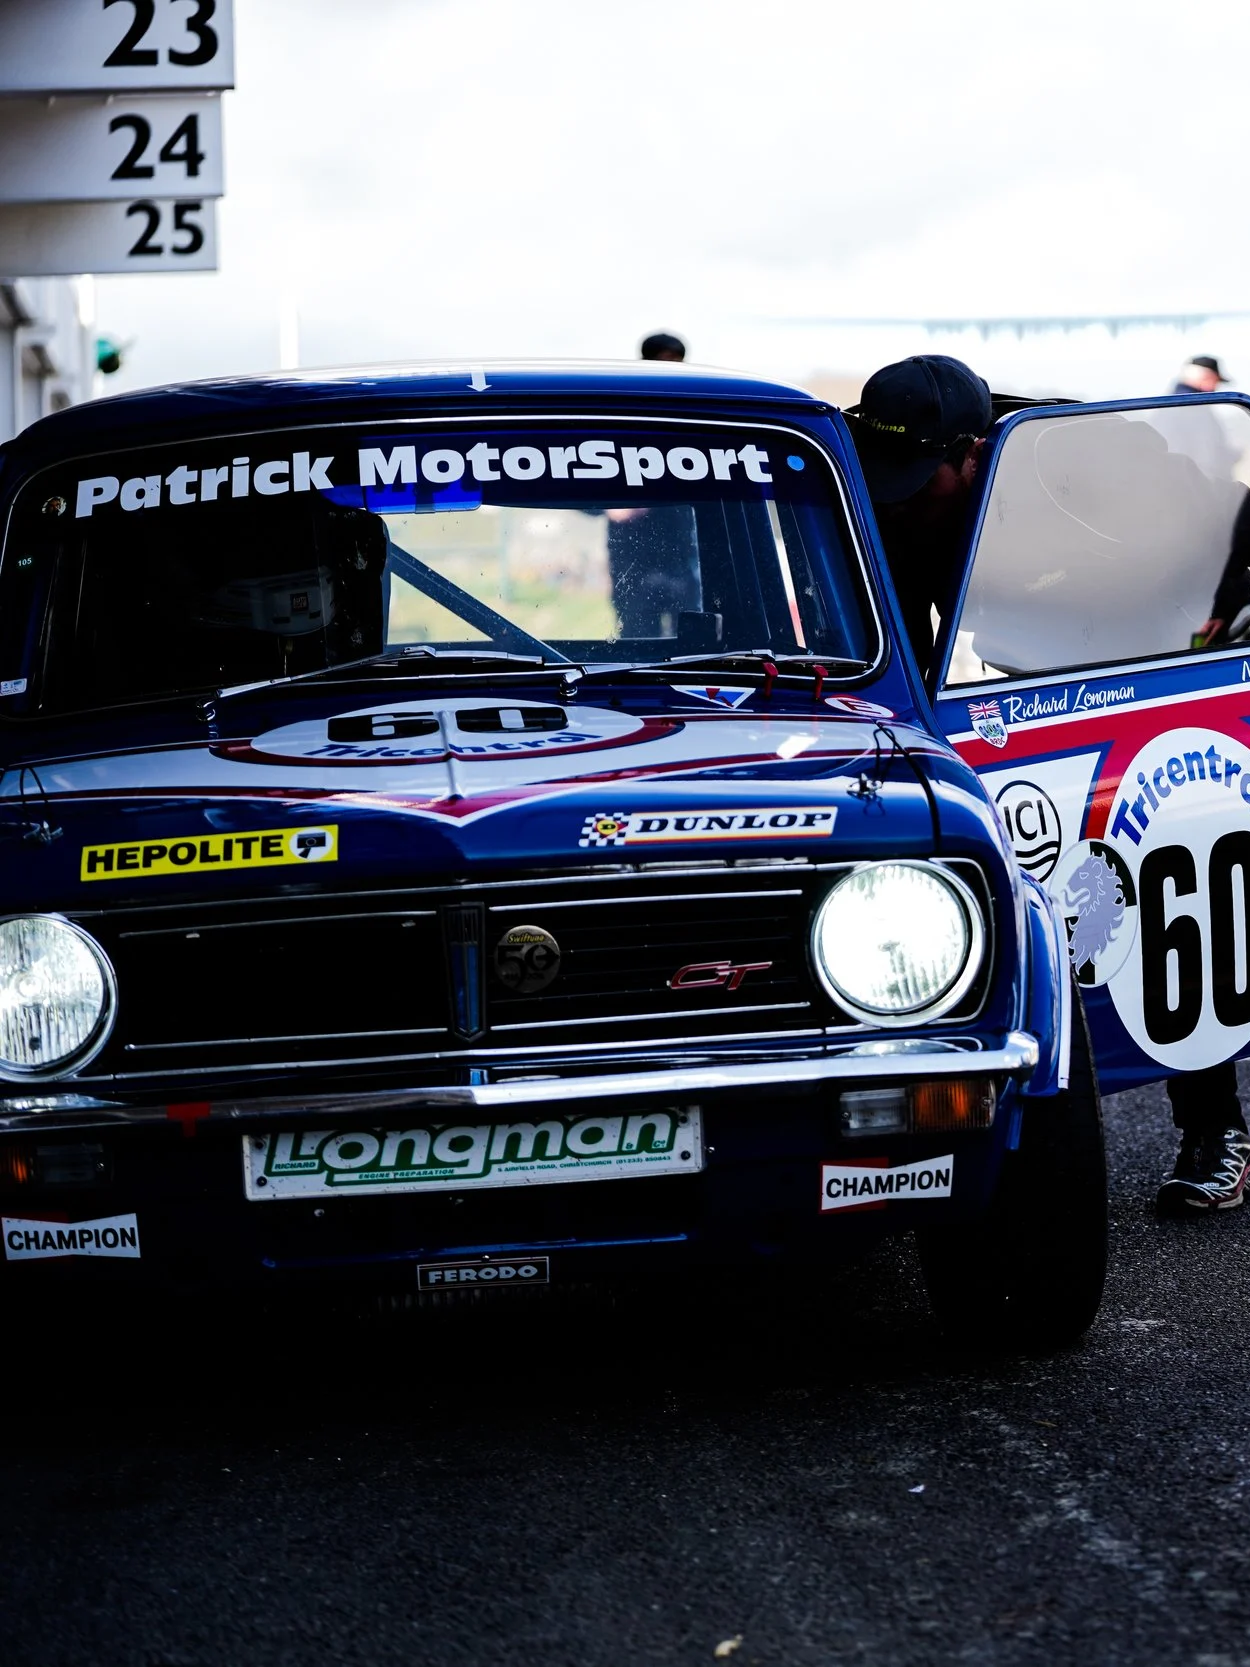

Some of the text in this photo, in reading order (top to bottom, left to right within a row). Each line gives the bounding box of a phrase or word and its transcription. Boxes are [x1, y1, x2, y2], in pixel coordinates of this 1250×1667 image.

[101, 0, 219, 68] 23
[108, 113, 205, 181] 24
[125, 200, 205, 258] 25
[75, 440, 773, 518] Patrick MotorSport
[1002, 684, 1135, 723] Richard Longman
[327, 706, 569, 742] 60
[634, 812, 832, 834] DUNLOP
[1003, 800, 1048, 842] ICI
[86, 834, 284, 874] HEPOLITE
[669, 960, 773, 991] GT
[271, 1112, 672, 1180] Longman
[273, 1161, 317, 1171] RICHARD
[358, 1168, 455, 1180] ENGINE PREPARATION
[504, 1165, 535, 1173] AIRFIELD
[821, 1168, 951, 1199] CHAMPION
[7, 1227, 137, 1251] CHAMPION
[428, 1265, 538, 1283] FERODO
